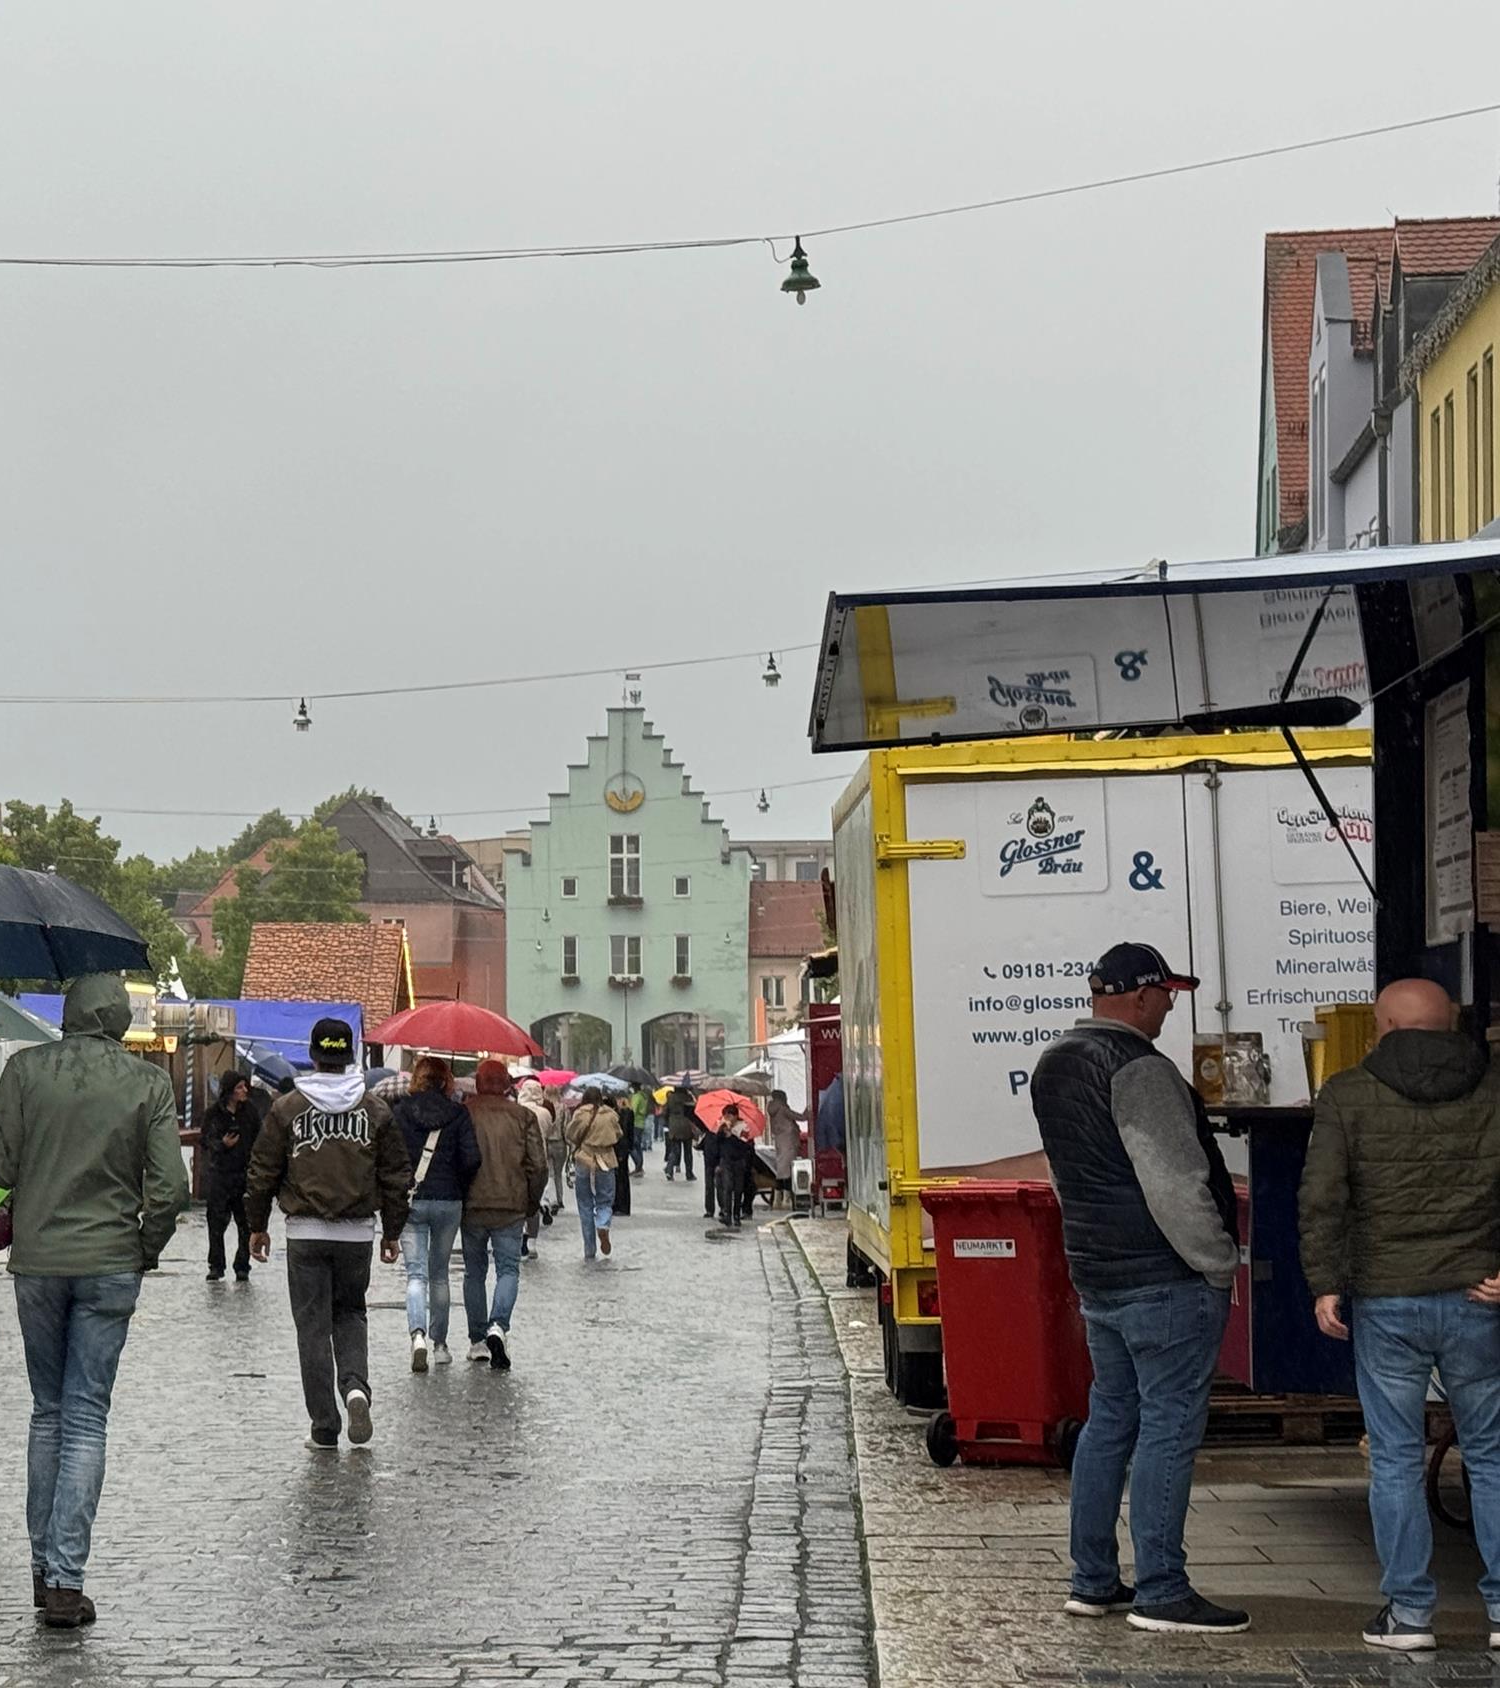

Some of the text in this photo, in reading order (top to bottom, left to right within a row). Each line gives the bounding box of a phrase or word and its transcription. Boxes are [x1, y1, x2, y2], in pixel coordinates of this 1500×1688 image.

[1000, 830, 1086, 877] Glossner
[1038, 857, 1084, 875] Bräu
[1128, 850, 1166, 891] &
[1280, 900, 1332, 917] Biere,
[1288, 929, 1376, 948] Spirituose
[1276, 957, 1375, 975] Mineralwäs
[968, 995, 1094, 1014] info@glossne
[956, 1241, 1003, 1251] NEUMARKT
